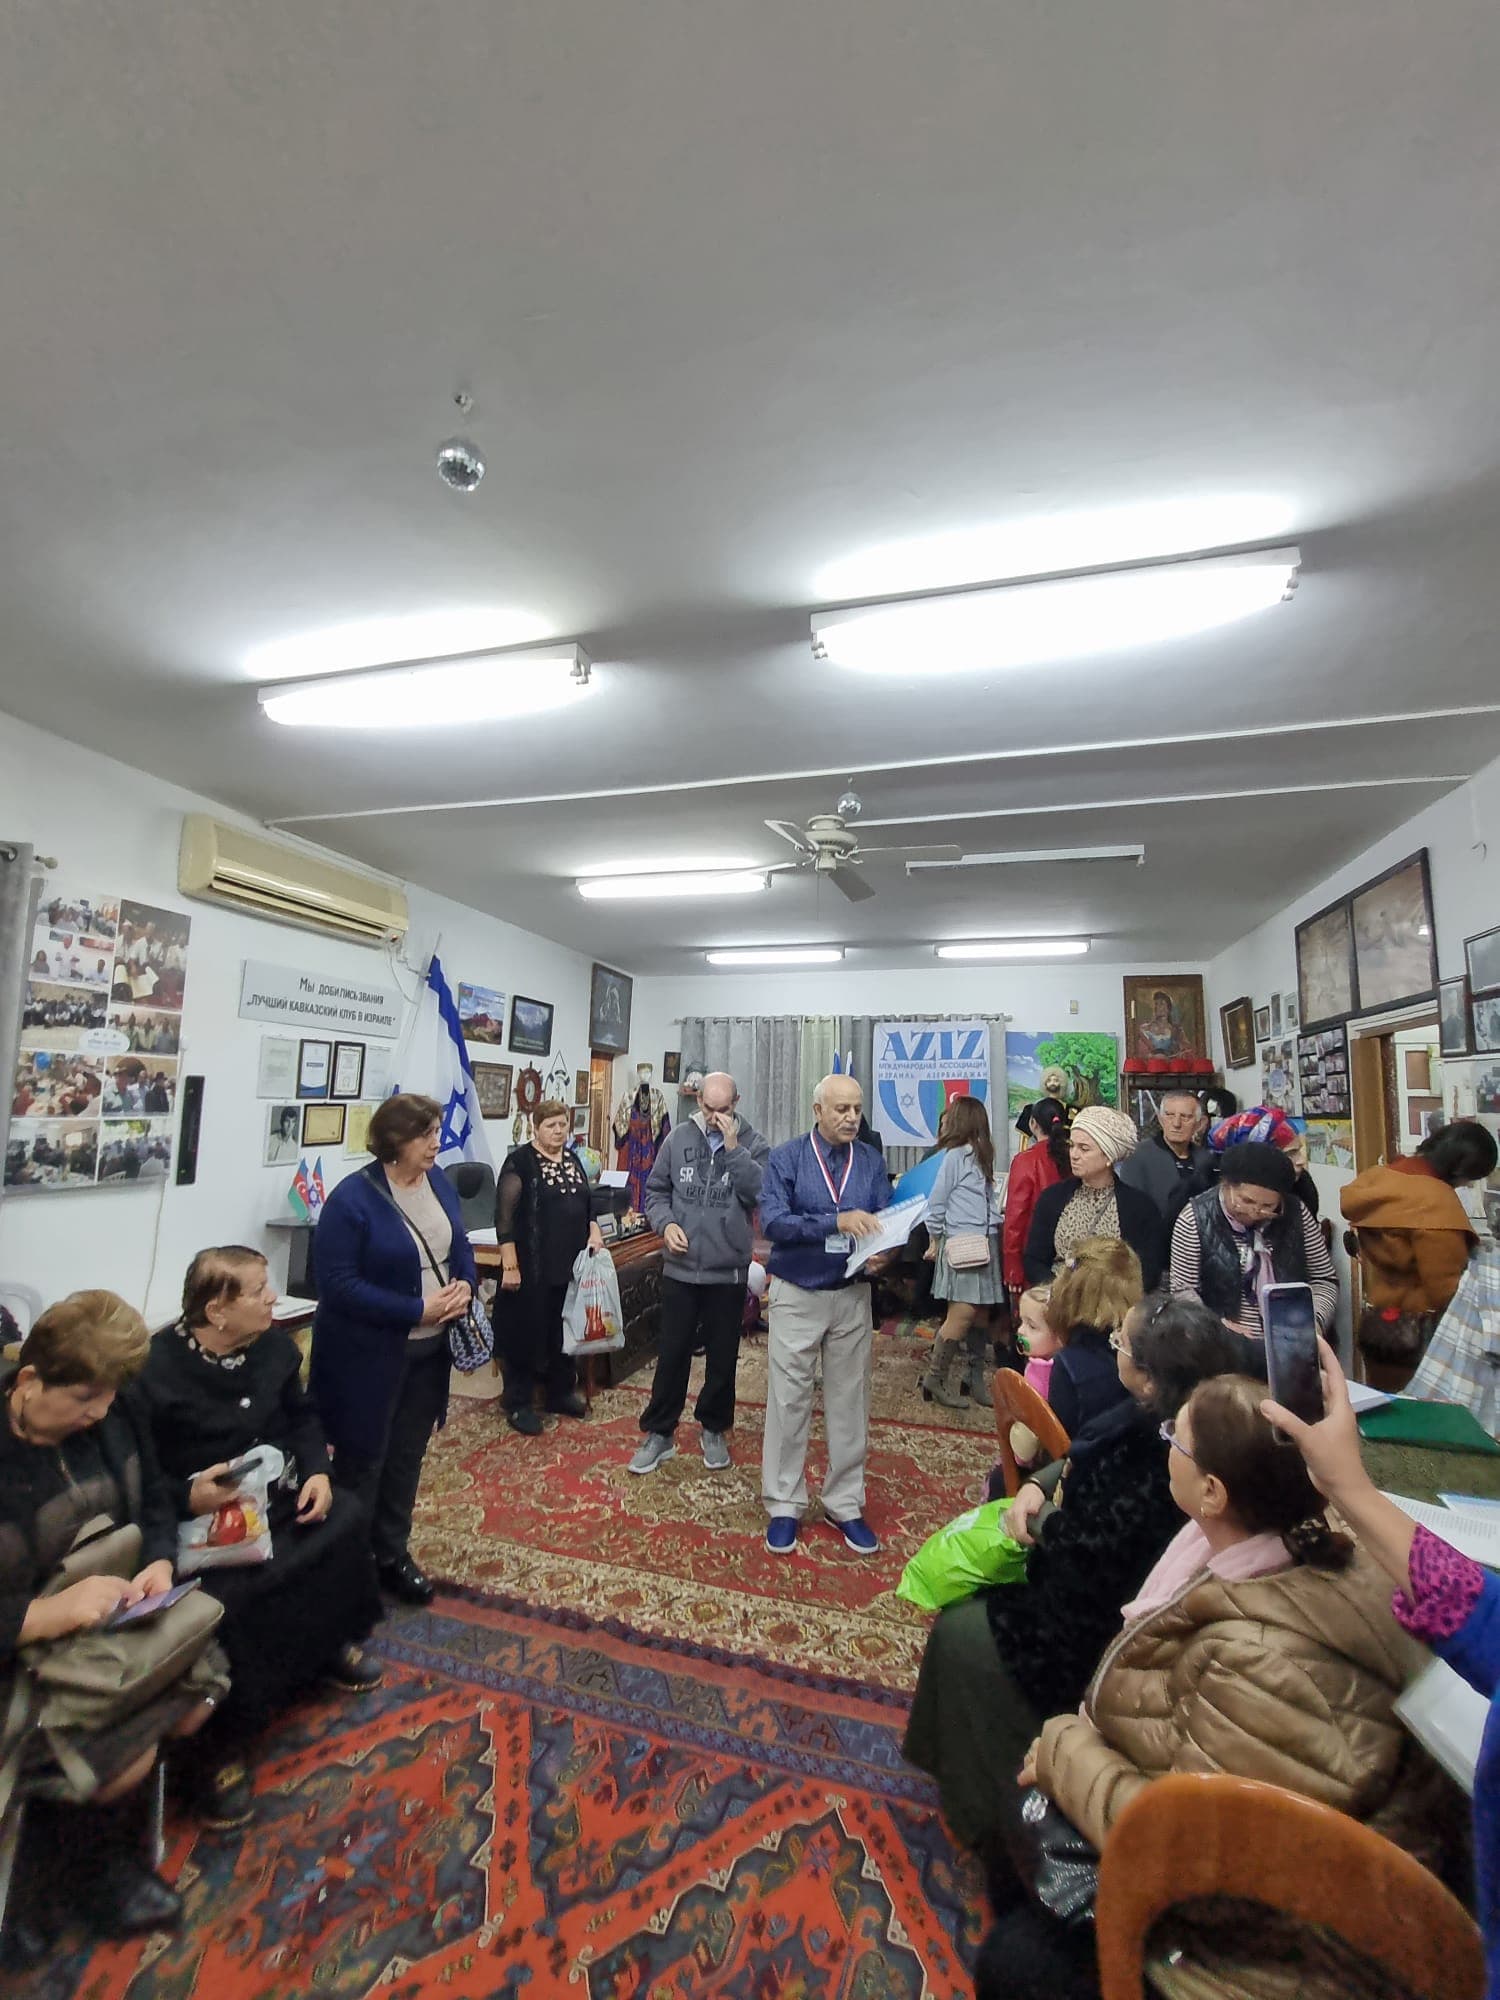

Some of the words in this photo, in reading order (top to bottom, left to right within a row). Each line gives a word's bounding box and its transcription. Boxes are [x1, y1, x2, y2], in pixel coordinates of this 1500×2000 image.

[358, 991, 384, 1005] ЗВАНИЯ
[339, 1007, 357, 1021] КЛУБ
[358, 1011, 363, 1022] В
[880, 1028, 985, 1061] AZIZ
[680, 1167, 693, 1182] SR
